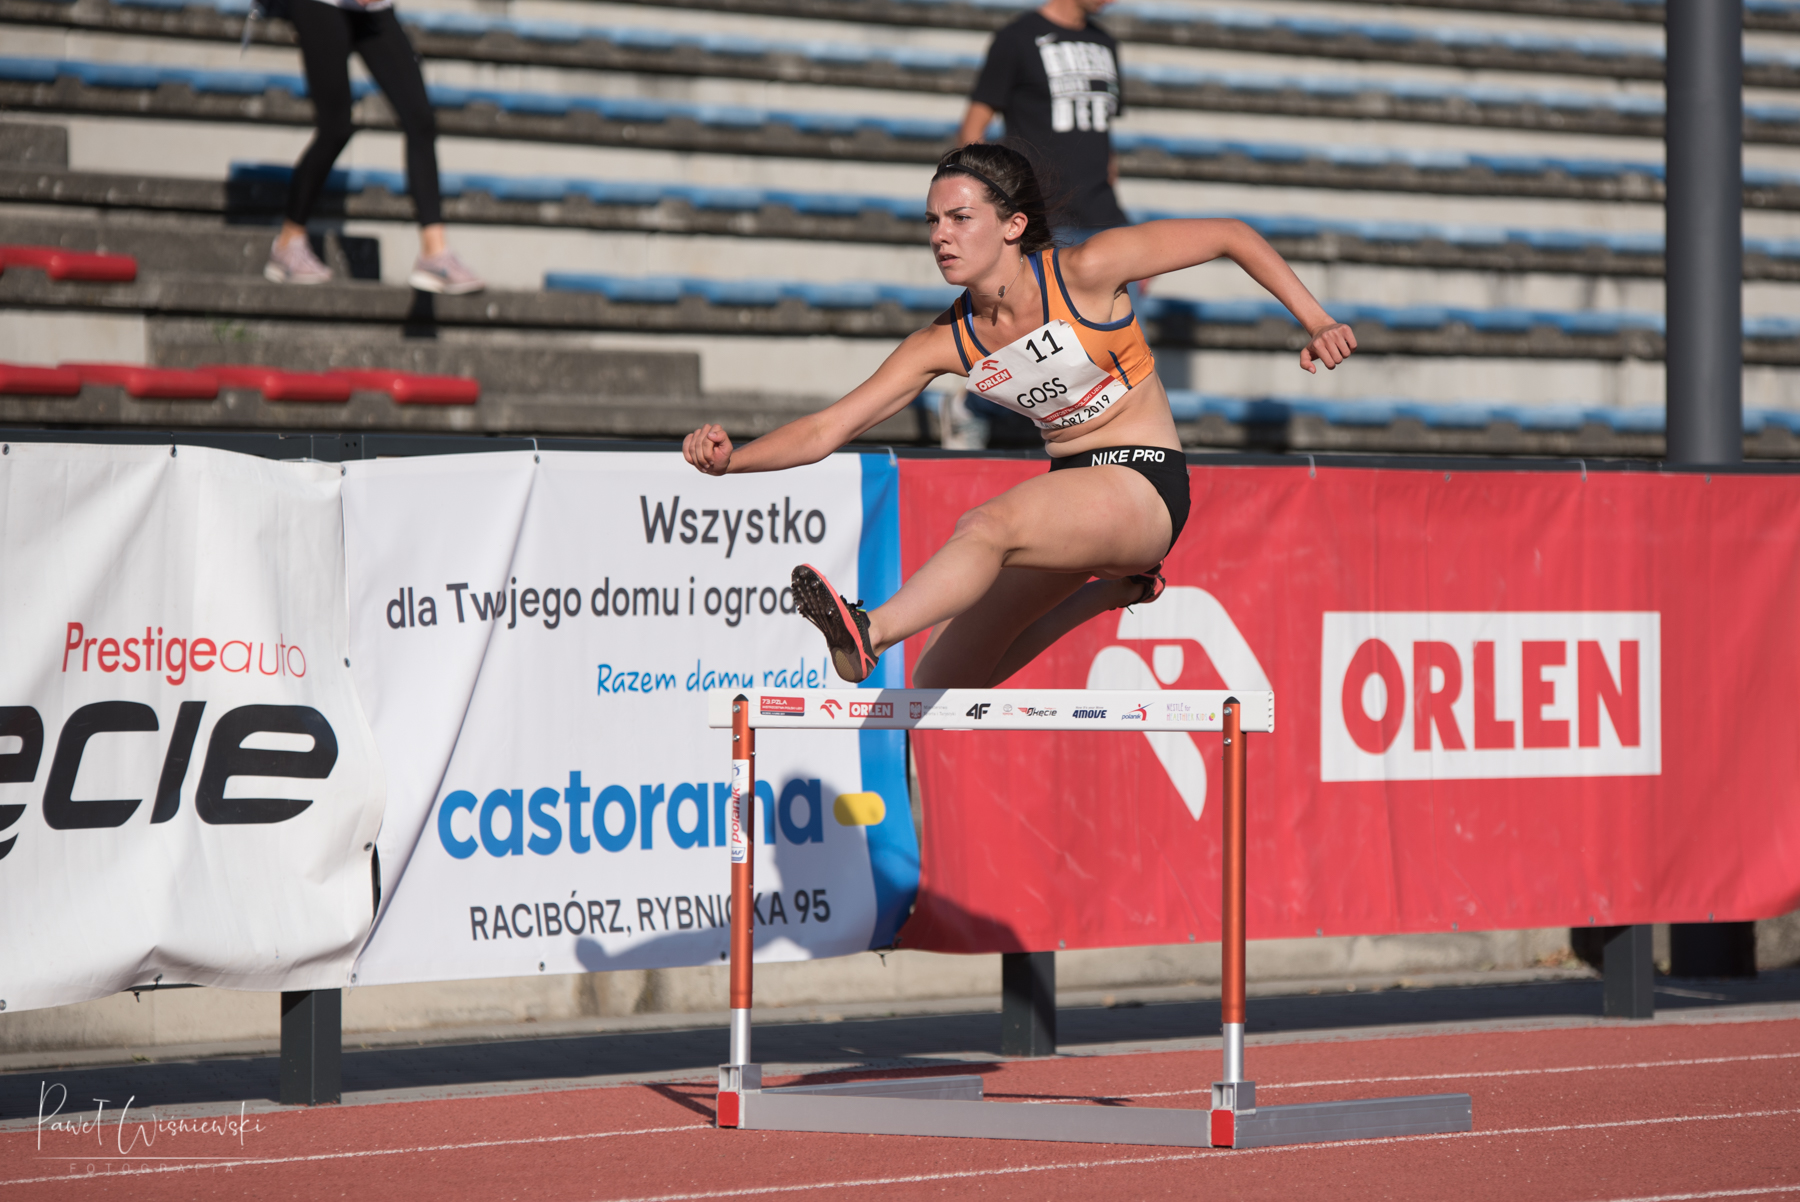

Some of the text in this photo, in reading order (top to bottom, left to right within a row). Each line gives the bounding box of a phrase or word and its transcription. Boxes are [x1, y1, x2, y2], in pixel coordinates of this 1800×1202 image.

[1025, 329, 1064, 363] 11
[977, 370, 1010, 391] ORLEN
[1016, 377, 1068, 409] GOSS
[1083, 394, 1111, 419] 2019
[1091, 449, 1166, 467] NIKE PRO
[640, 495, 827, 559] Wszystko
[386, 586, 438, 630] dla
[591, 576, 680, 617] domu
[690, 576, 696, 616] i
[704, 584, 798, 628] ogrod
[62, 621, 307, 687] Prestigeauto
[597, 663, 677, 696] Razem
[850, 703, 891, 716] ORLEN
[965, 702, 992, 720] 4F
[1341, 636, 1641, 756] ORLEN
[1072, 709, 1108, 719] 4MOVE
[1121, 713, 1142, 721] polanik
[437, 770, 825, 860] castorama
[469, 889, 831, 941] RACIBÓRZ, RYBNIKA 95
